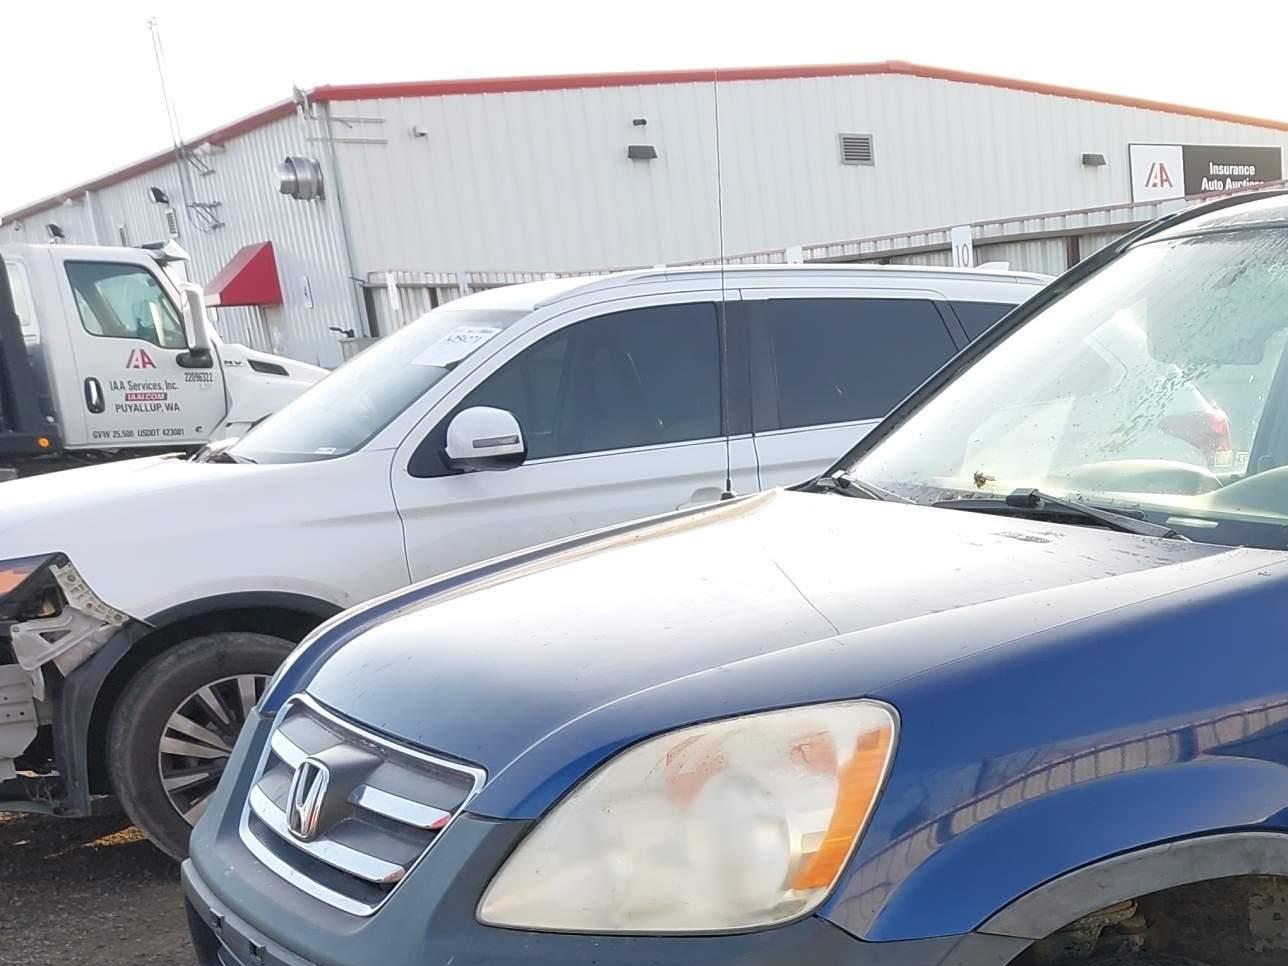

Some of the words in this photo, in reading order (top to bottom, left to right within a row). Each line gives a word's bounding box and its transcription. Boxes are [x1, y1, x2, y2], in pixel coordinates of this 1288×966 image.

[1209, 162, 1255, 175] Insurance
[1201, 177, 1224, 191] Auto
[109, 380, 126, 391] IAA
[127, 380, 165, 393] Services,
[165, 402, 181, 411] WA
[92, 430, 110, 439] GVW
[137, 428, 161, 437] USDOT
